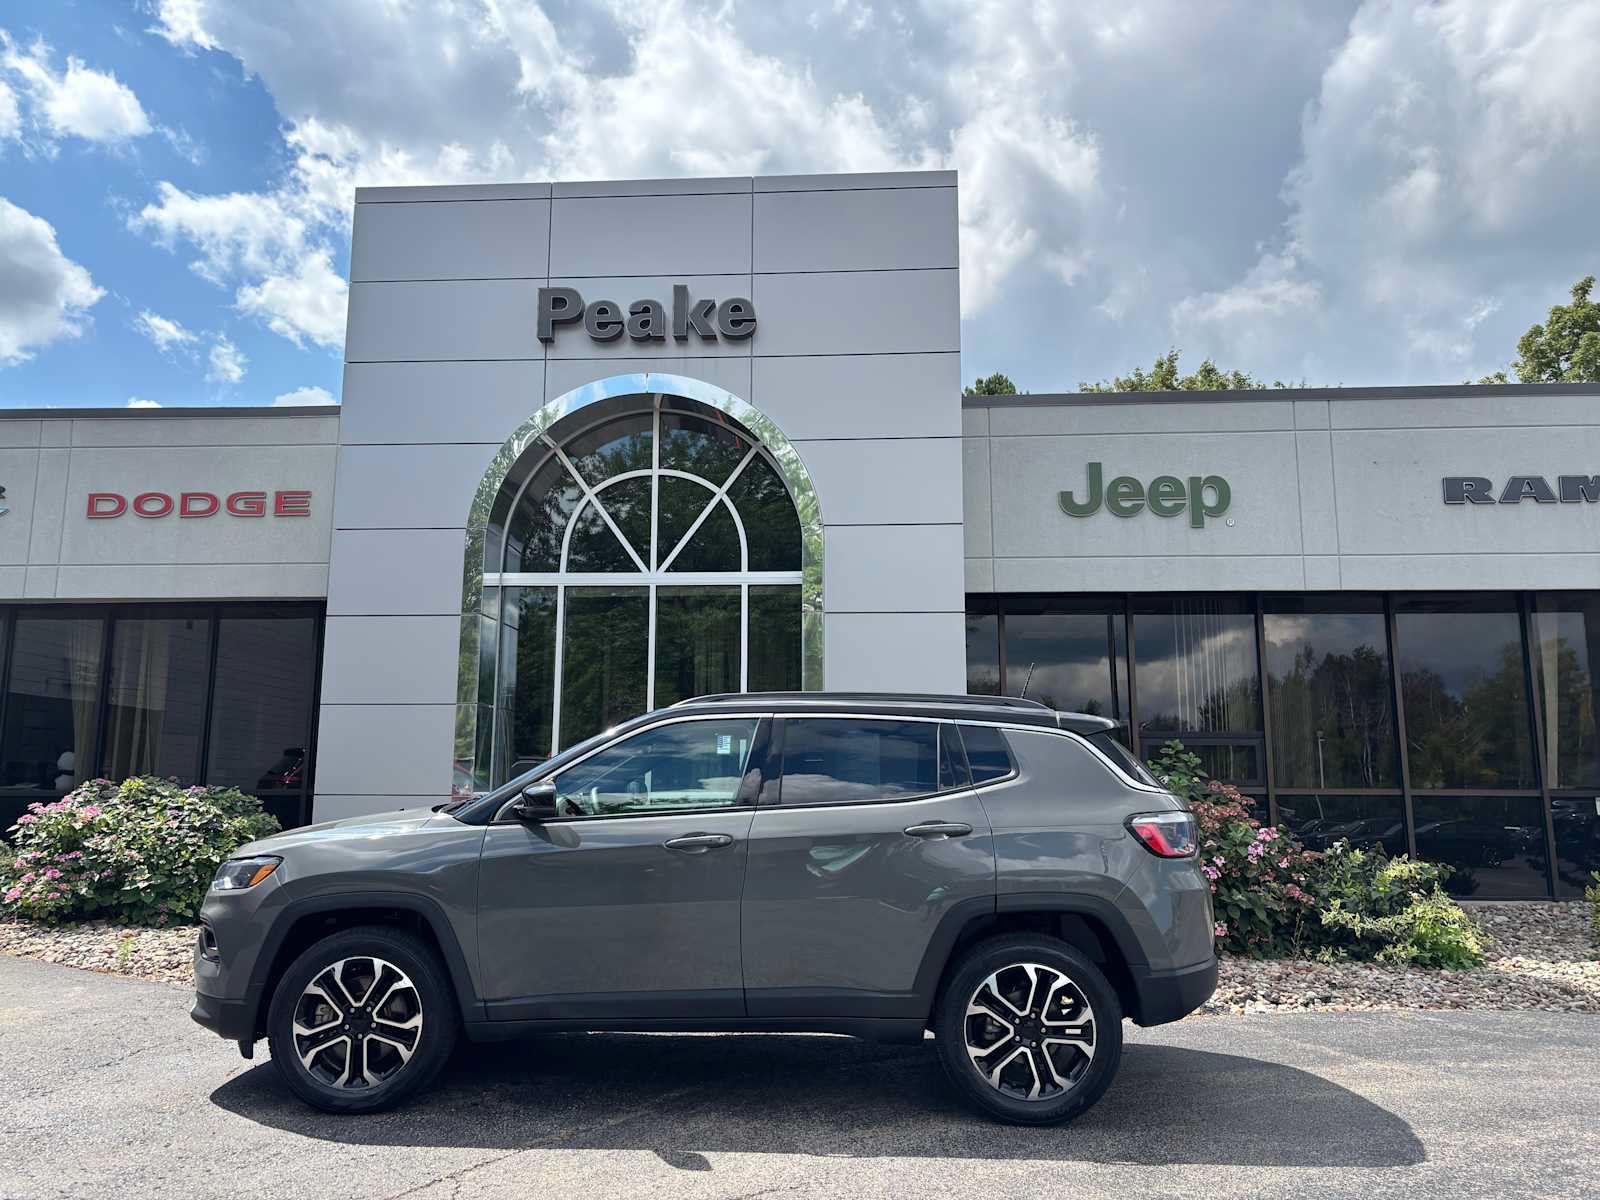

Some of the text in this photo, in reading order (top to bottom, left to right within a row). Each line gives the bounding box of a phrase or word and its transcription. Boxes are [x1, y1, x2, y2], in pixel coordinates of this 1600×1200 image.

[537, 284, 757, 343] Peake
[87, 490, 312, 518] DODGE
[1058, 462, 1231, 528] Jeep
[1443, 475, 1600, 504] RAM
